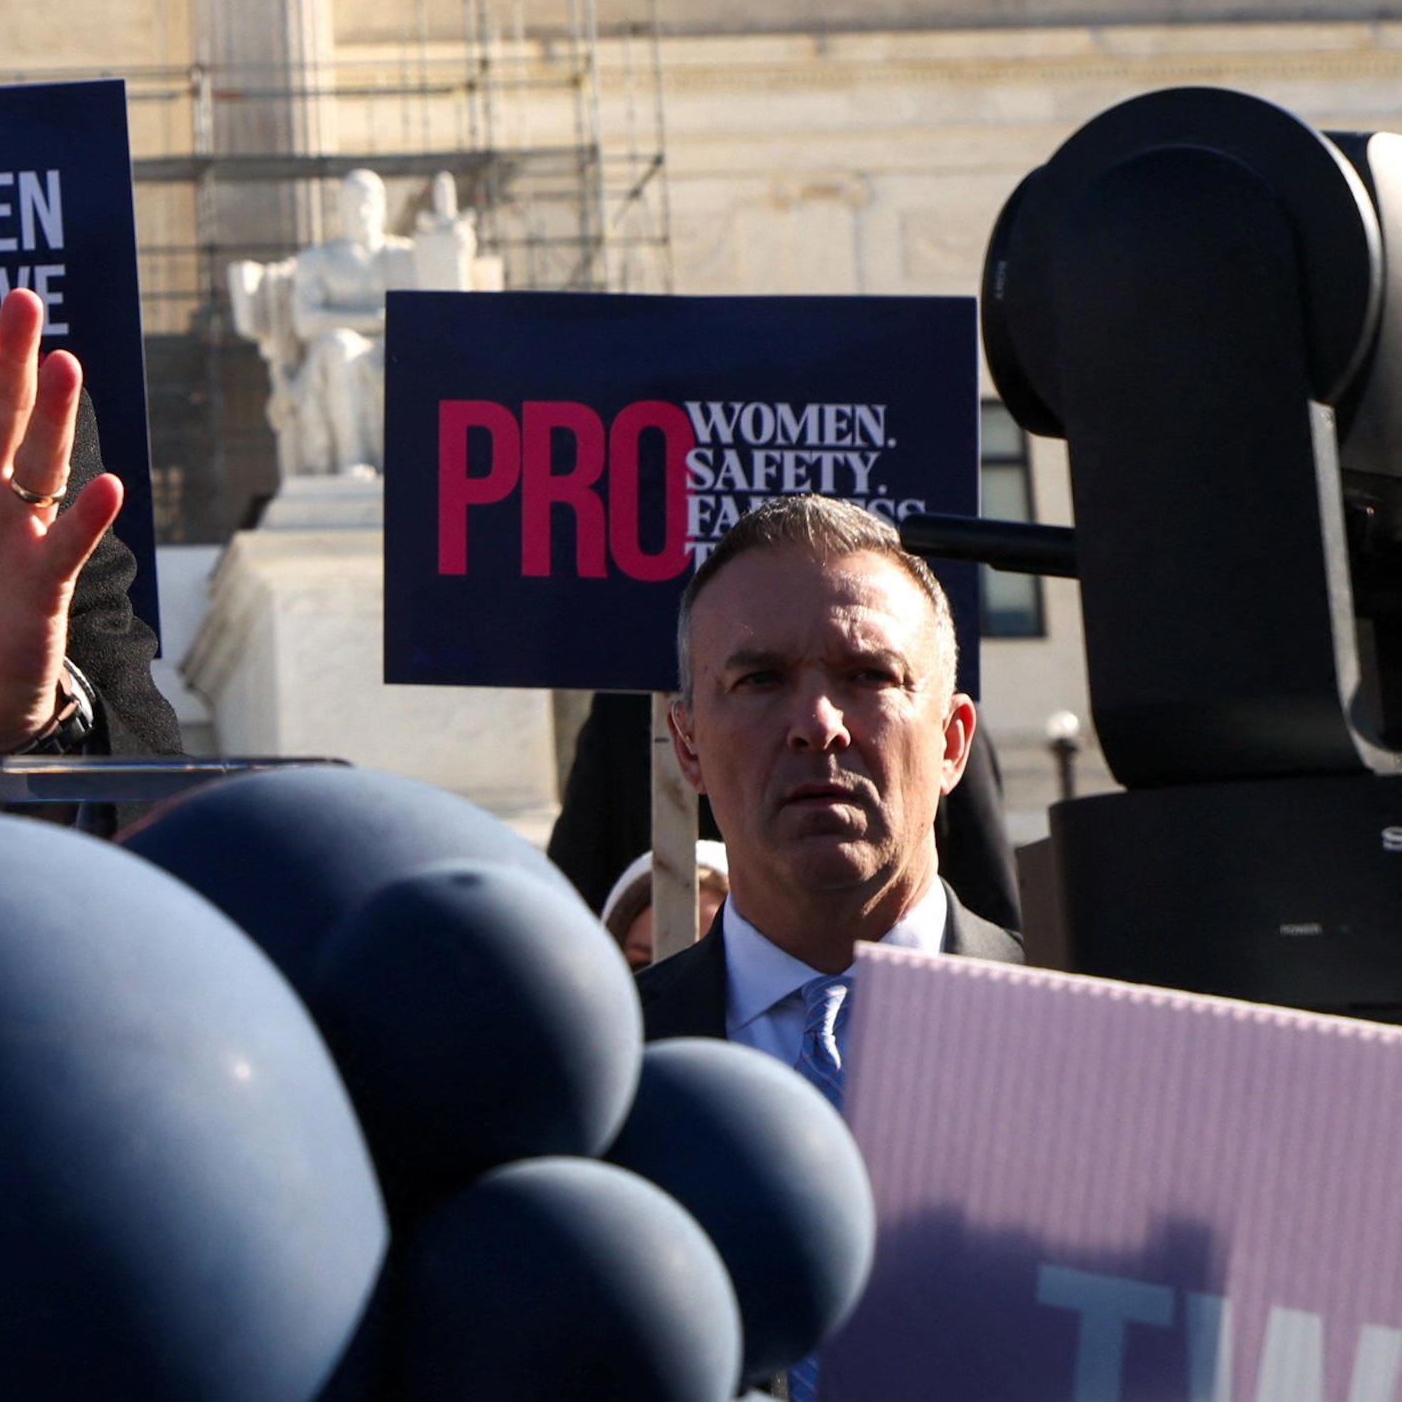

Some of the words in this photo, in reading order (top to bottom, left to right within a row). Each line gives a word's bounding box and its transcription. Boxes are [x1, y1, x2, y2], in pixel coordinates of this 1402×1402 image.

[684, 400, 896, 448] WOMEN.
[438, 399, 697, 582] PRO
[685, 448, 888, 495] SAFETY.
